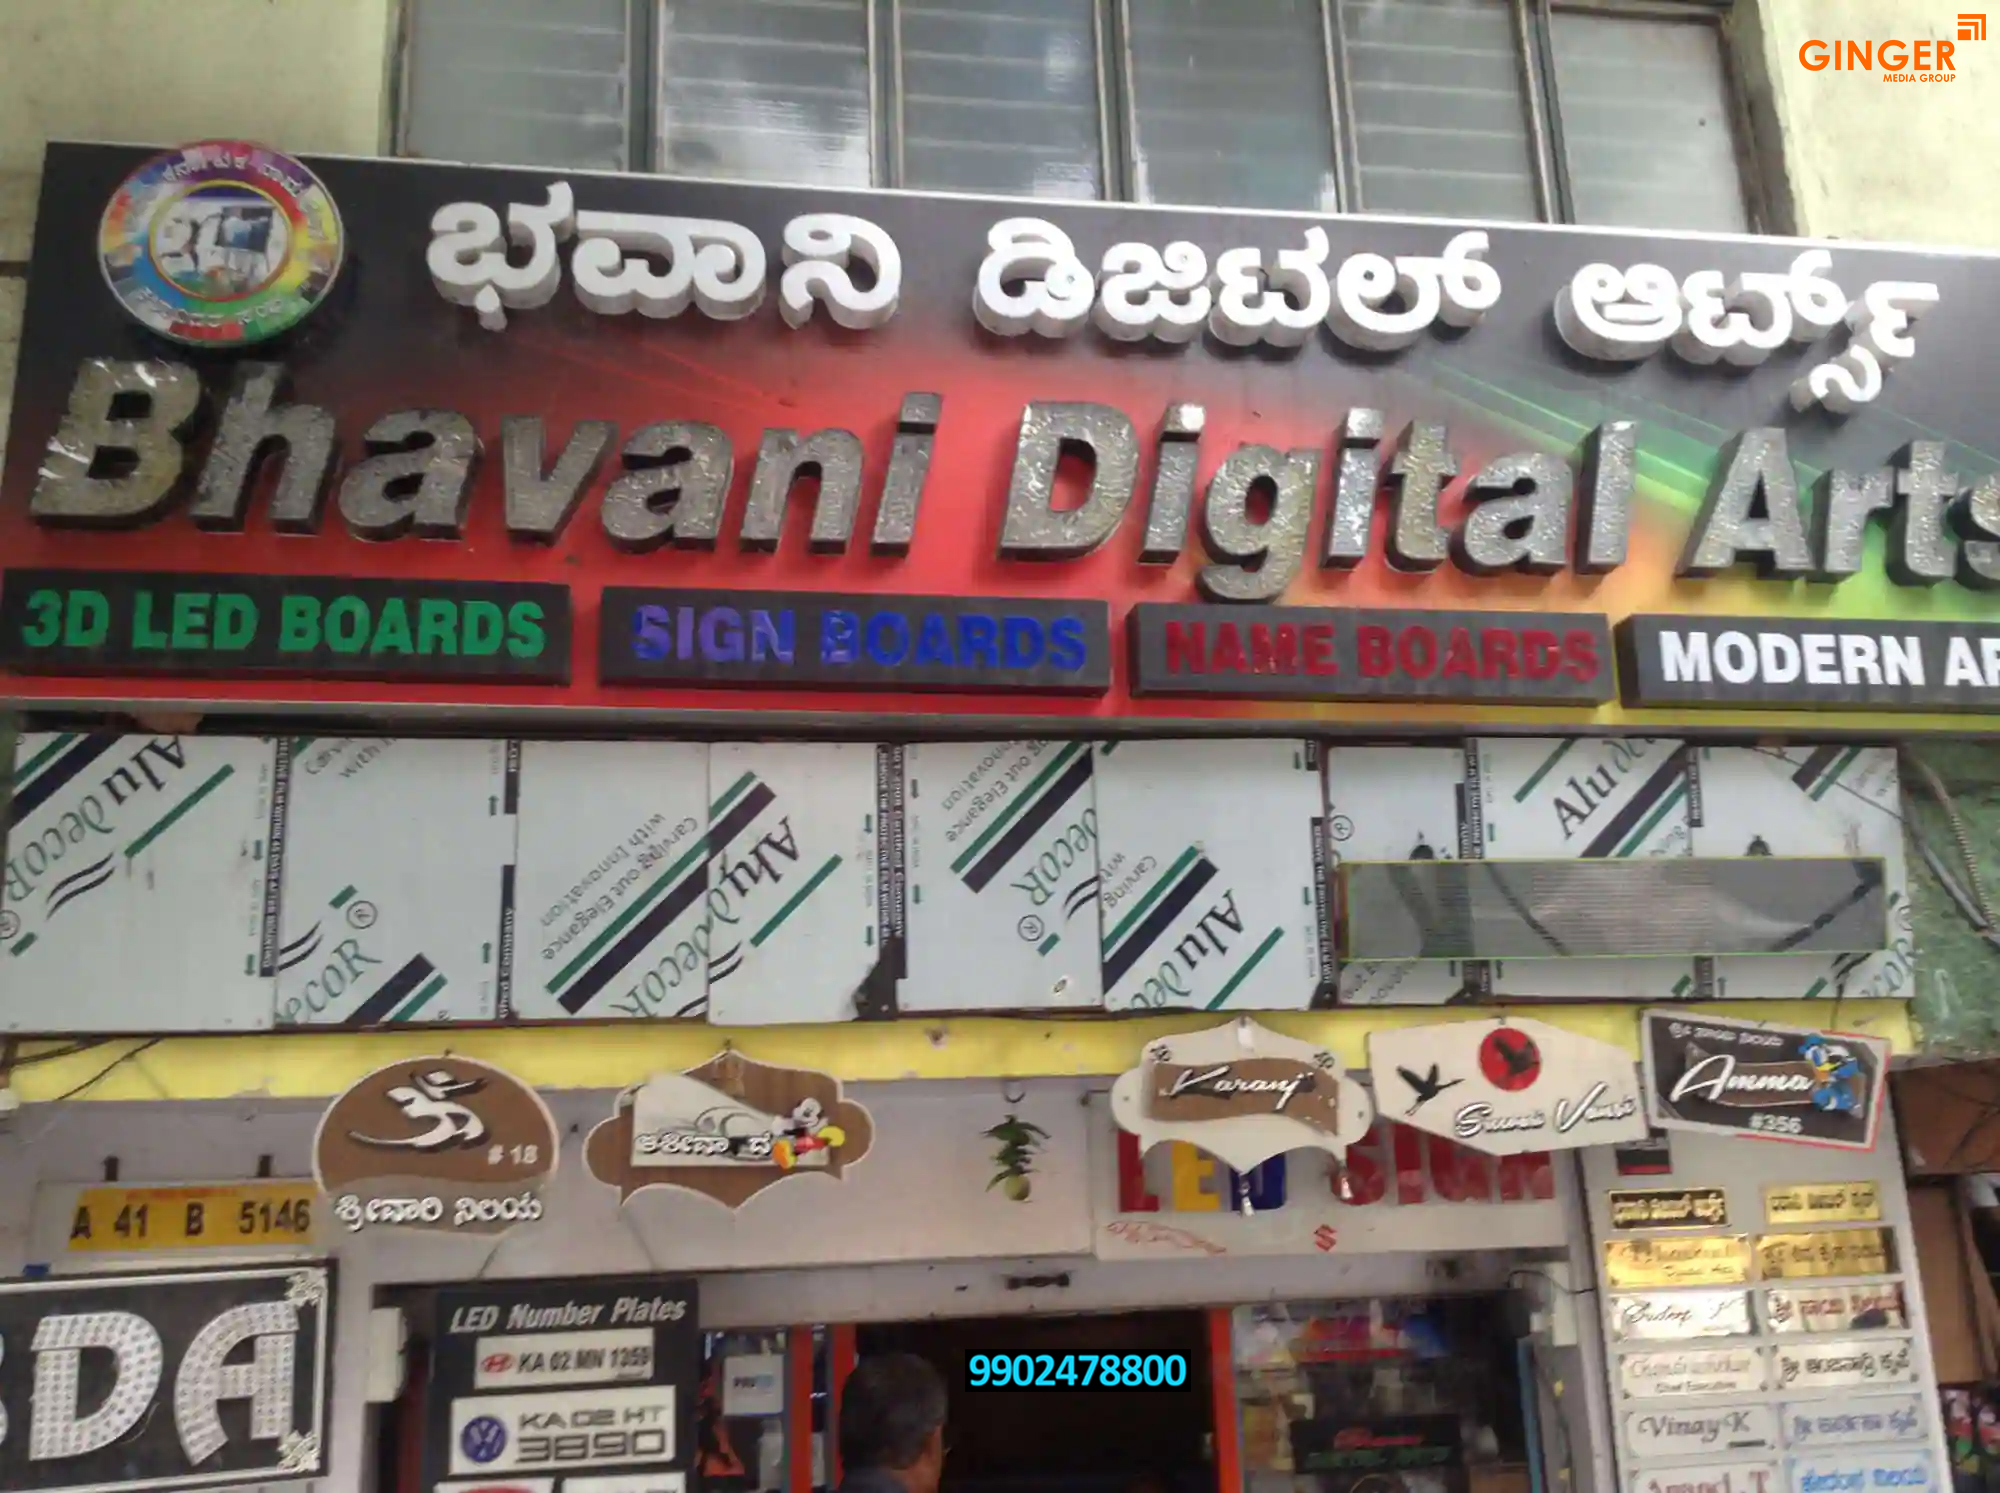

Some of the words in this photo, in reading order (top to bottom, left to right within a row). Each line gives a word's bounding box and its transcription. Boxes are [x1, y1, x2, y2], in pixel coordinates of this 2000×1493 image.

[427, 181, 902, 330] ಭವಾನಿ
[974, 217, 1501, 351] ಡಿಜಿಟಲ್
[30, 356, 943, 560] Bhavani
[997, 401, 1636, 600] Digital
[22, 588, 110, 649] 3D
[132, 591, 258, 652] LED
[278, 594, 547, 659] BOARDS
[631, 604, 795, 667] SIGN
[819, 609, 1087, 673] BOARDS
[1165, 619, 1339, 677] NAME
[1355, 624, 1602, 682] BOARDS
[1659, 629, 1926, 687] MODERN
[1669, 1053, 1815, 1103] Amma
[113, 1203, 149, 1238] 41
[185, 1202, 204, 1237] B
[238, 1198, 311, 1235] 5146
[449, 1305, 500, 1334] LED
[506, 1300, 605, 1330] Number
[609, 1295, 687, 1324] Plates
[0, 1300, 300, 1467] DA
[516, 1352, 546, 1374] KA
[518, 1411, 567, 1431] KA
